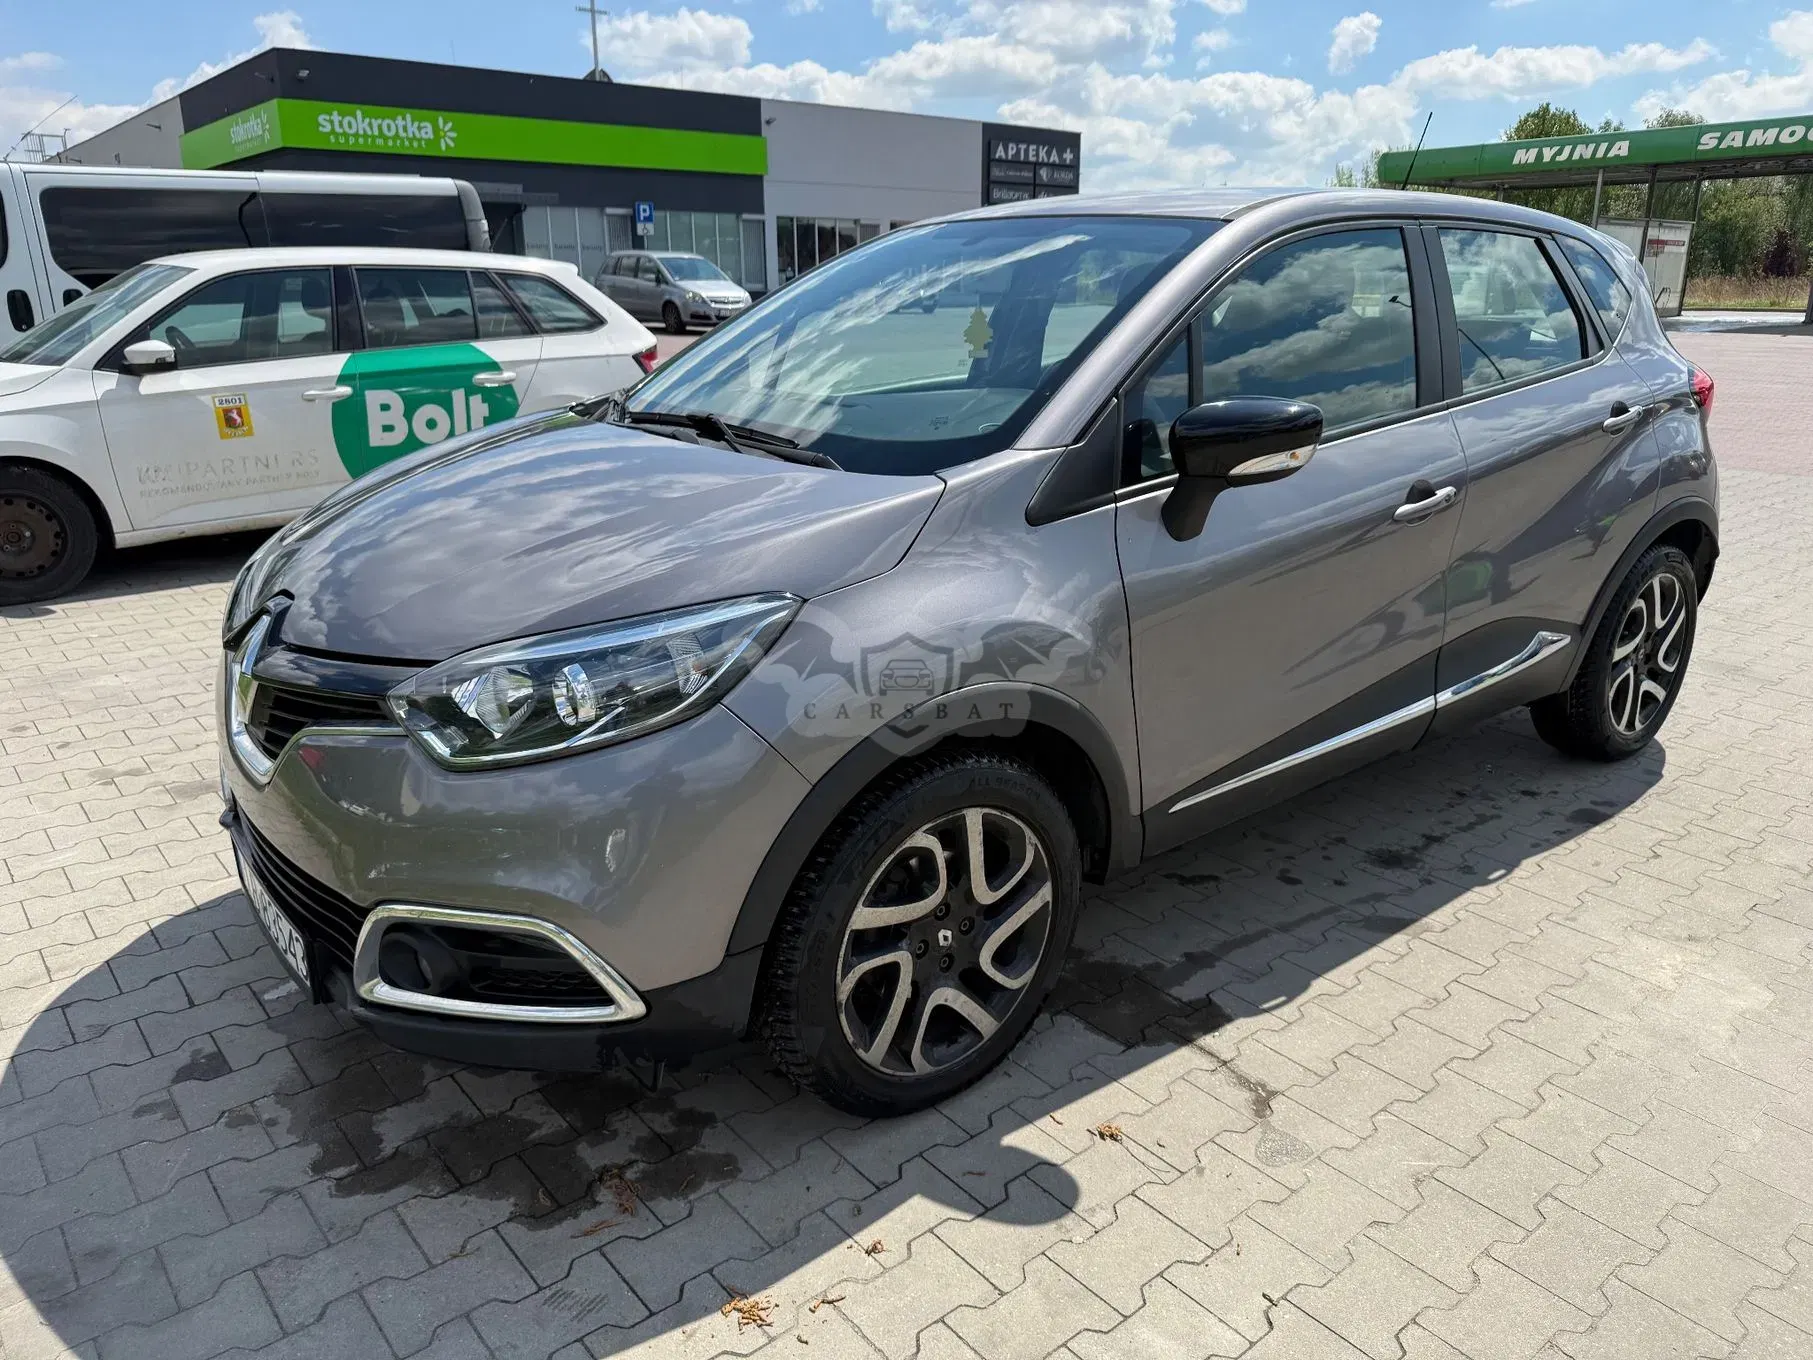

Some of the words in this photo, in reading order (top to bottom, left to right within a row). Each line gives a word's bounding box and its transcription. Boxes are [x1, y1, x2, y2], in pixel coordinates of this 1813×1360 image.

[230, 111, 263, 144] stokrotka
[317, 109, 434, 140] stokrotka
[329, 134, 427, 149] supermarket
[995, 141, 1059, 164] APTEKA
[1511, 139, 1630, 167] MYJNIA
[1696, 125, 1813, 150] SAMO
[639, 205, 651, 221] P
[365, 388, 490, 448] Bolt
